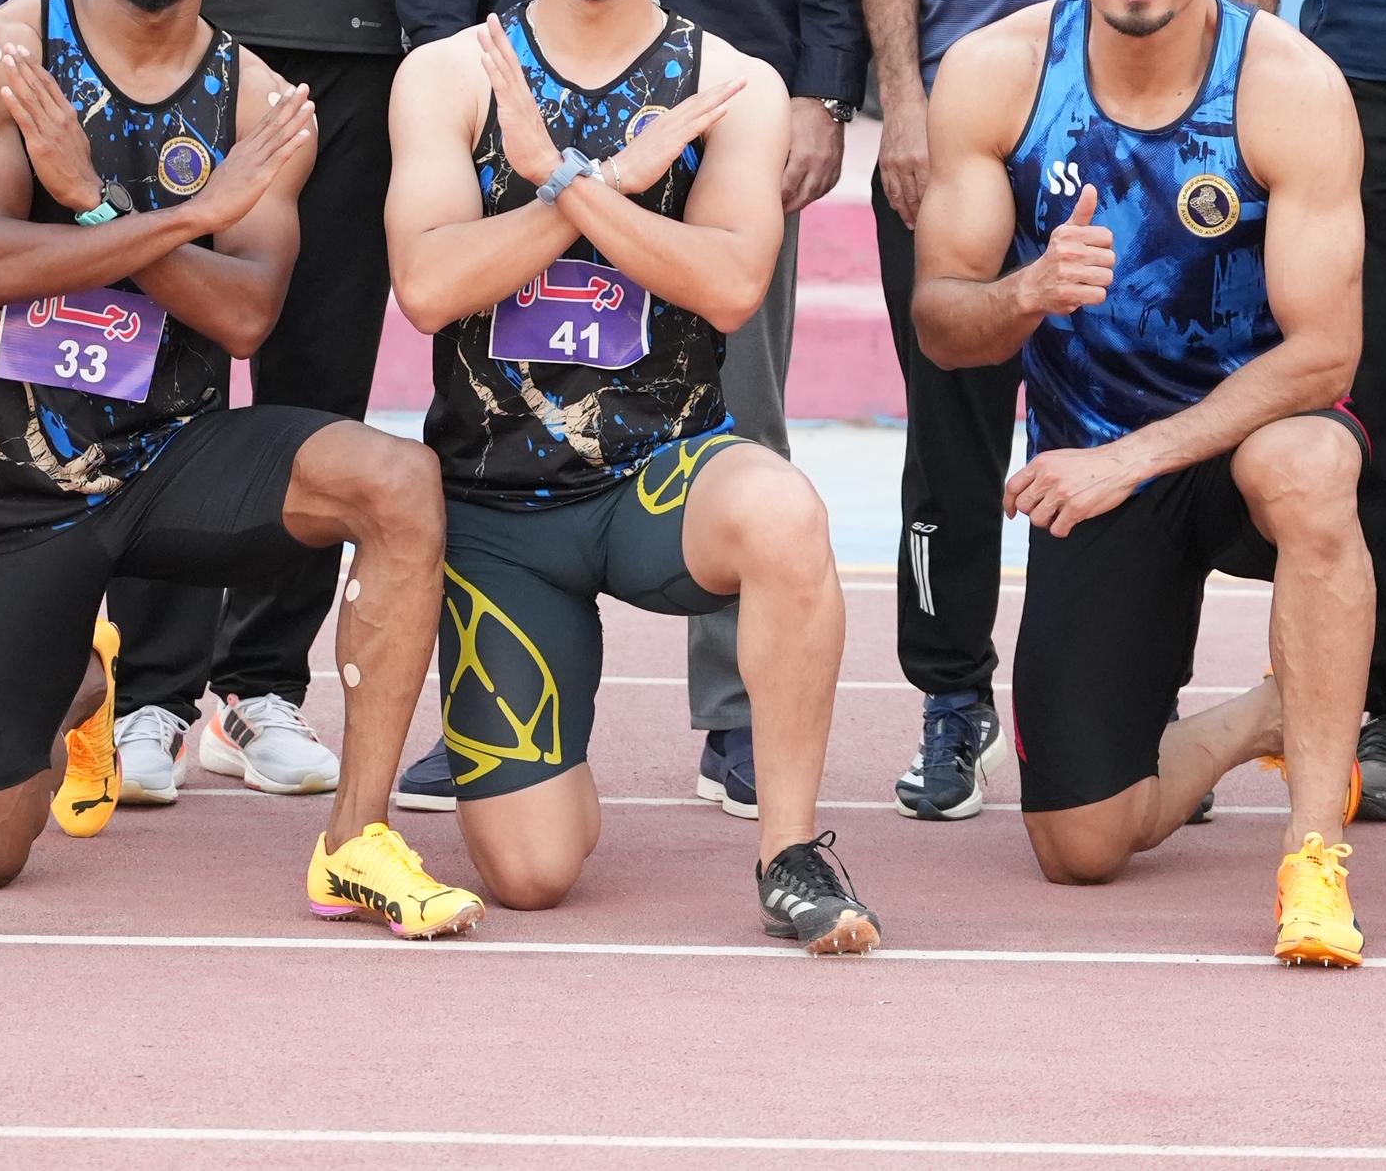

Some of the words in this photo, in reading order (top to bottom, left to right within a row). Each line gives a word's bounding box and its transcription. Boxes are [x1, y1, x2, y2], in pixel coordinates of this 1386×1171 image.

[1181, 209, 1203, 233] ALHASHID
[549, 320, 599, 359] 41
[54, 339, 108, 383] 33
[325, 867, 403, 925] NITRO
